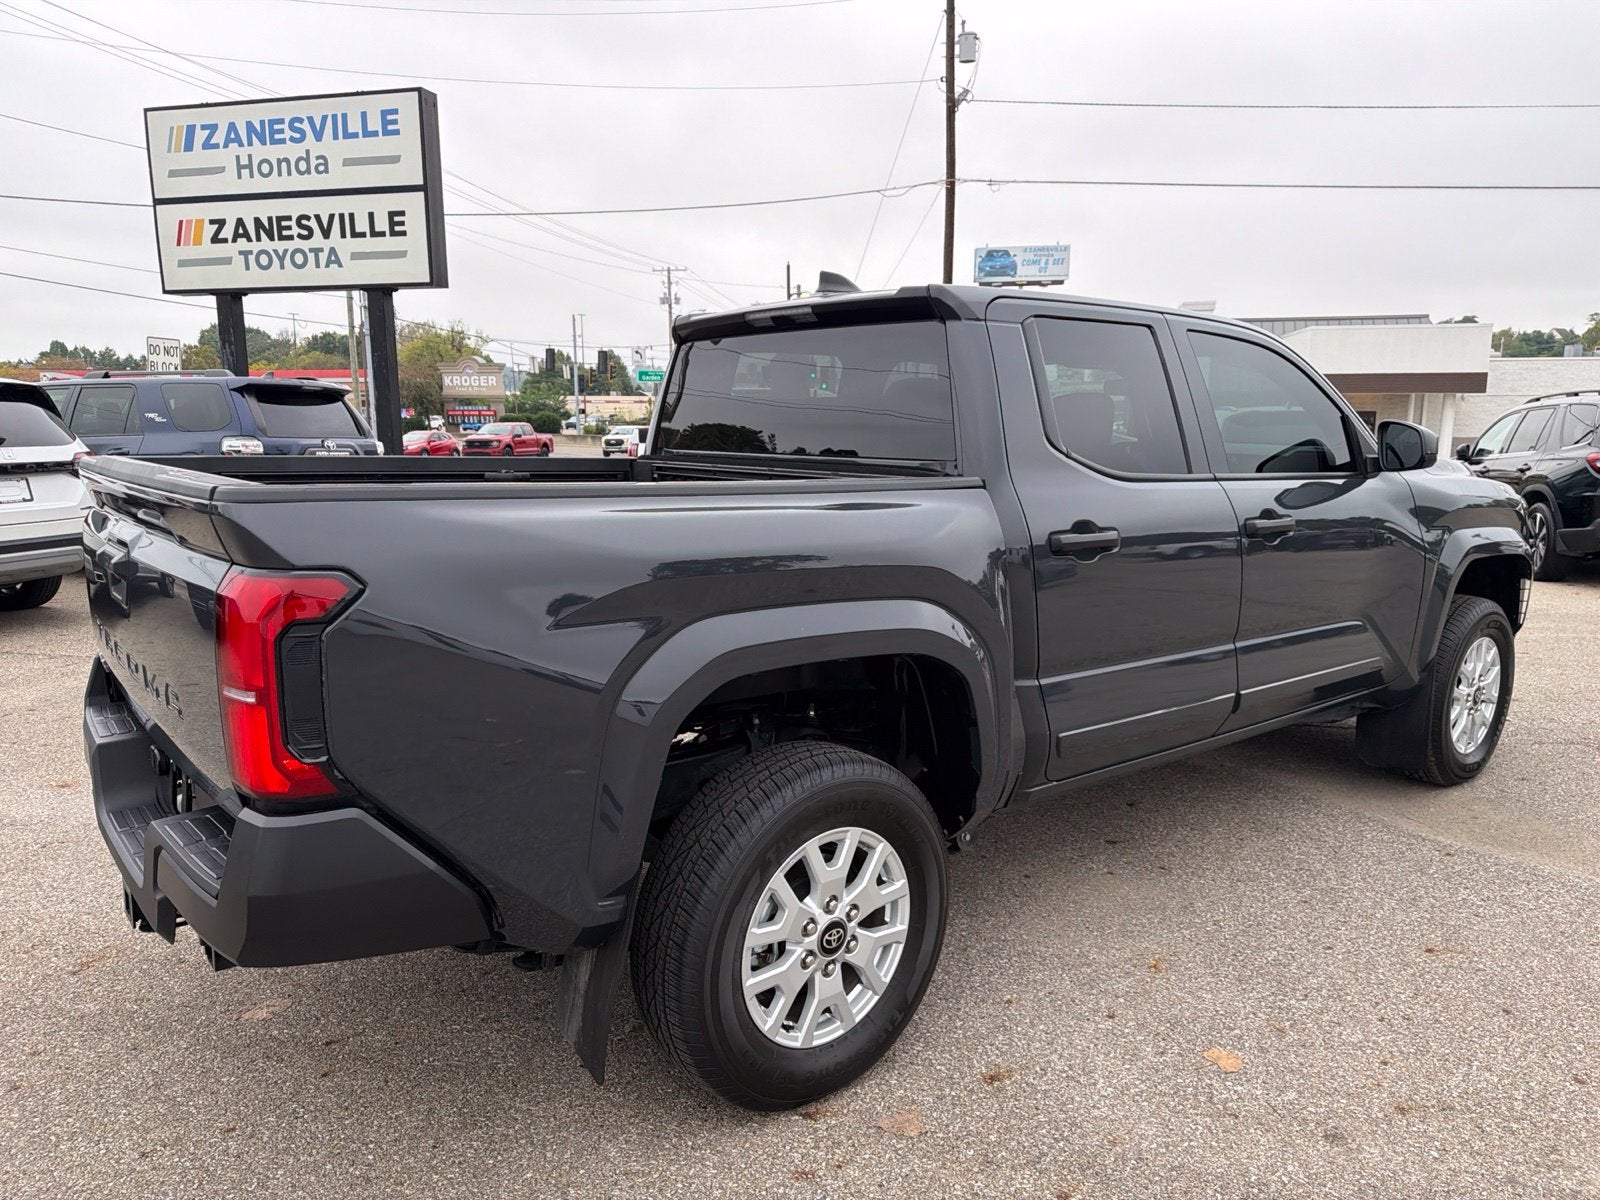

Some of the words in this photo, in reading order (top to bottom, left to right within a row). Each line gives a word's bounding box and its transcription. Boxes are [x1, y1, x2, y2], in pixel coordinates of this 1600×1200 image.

[199, 107, 401, 151] ZANESVILLE
[235, 149, 329, 179] Honda
[208, 210, 408, 245] ZANESVILLE
[238, 246, 344, 271] TOYOTA
[149, 344, 160, 356] DO
[163, 345, 179, 358] NOT
[149, 360, 179, 372] BLOCK
[444, 375, 497, 387] KROGER
